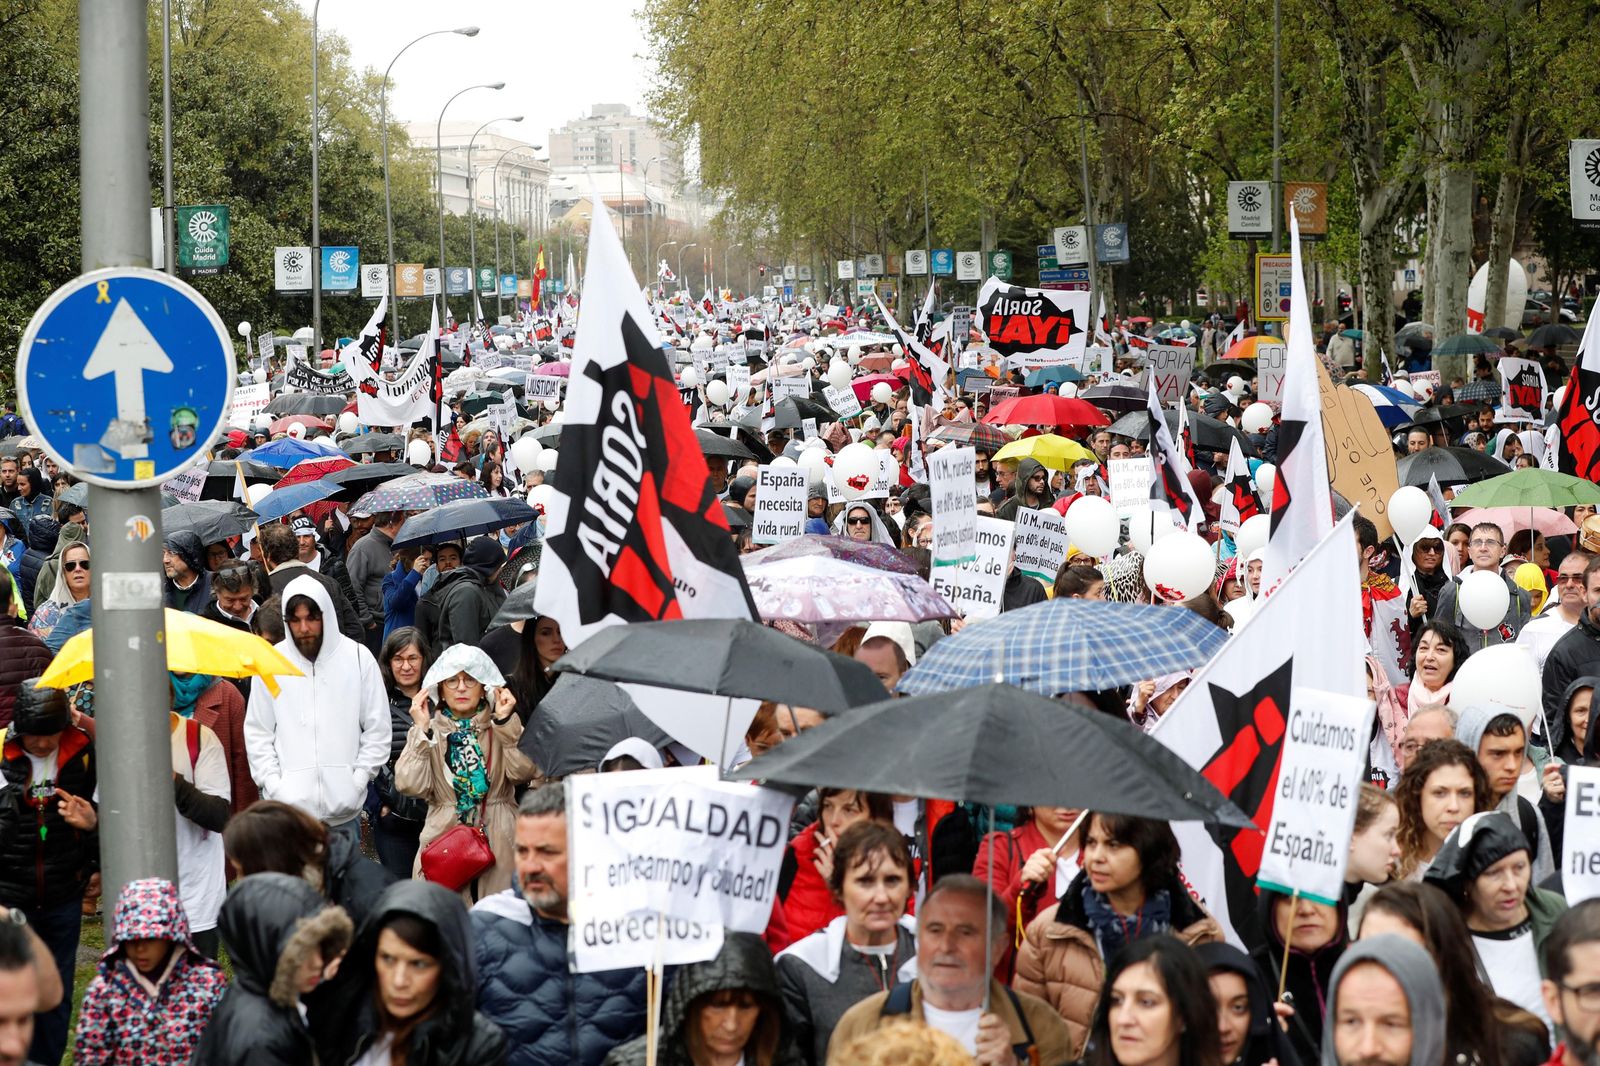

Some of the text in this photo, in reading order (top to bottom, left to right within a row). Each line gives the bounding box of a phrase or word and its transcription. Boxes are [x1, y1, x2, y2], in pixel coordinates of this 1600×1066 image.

[1148, 349, 1192, 370] SORIA
[1521, 374, 1539, 388] SORIA
[1510, 385, 1541, 408] ¡YA!
[952, 458, 972, 478] rurales
[760, 471, 804, 490] España
[1123, 478, 1135, 490] 60%
[1360, 472, 1385, 514] QUE
[759, 496, 803, 512] necesita
[936, 501, 942, 514] en
[944, 494, 954, 513] 60%
[758, 521, 802, 536] vida rural.
[1019, 510, 1030, 526] 10
[1030, 514, 1041, 530] M.,
[937, 528, 958, 554] pedimos
[1017, 533, 1064, 556] en 60% del país,
[985, 557, 1002, 576] de
[934, 578, 997, 604] España.
[1291, 710, 1355, 752] Cuidamos
[1282, 767, 1348, 809] el 60% de
[1270, 821, 1337, 868] España.
